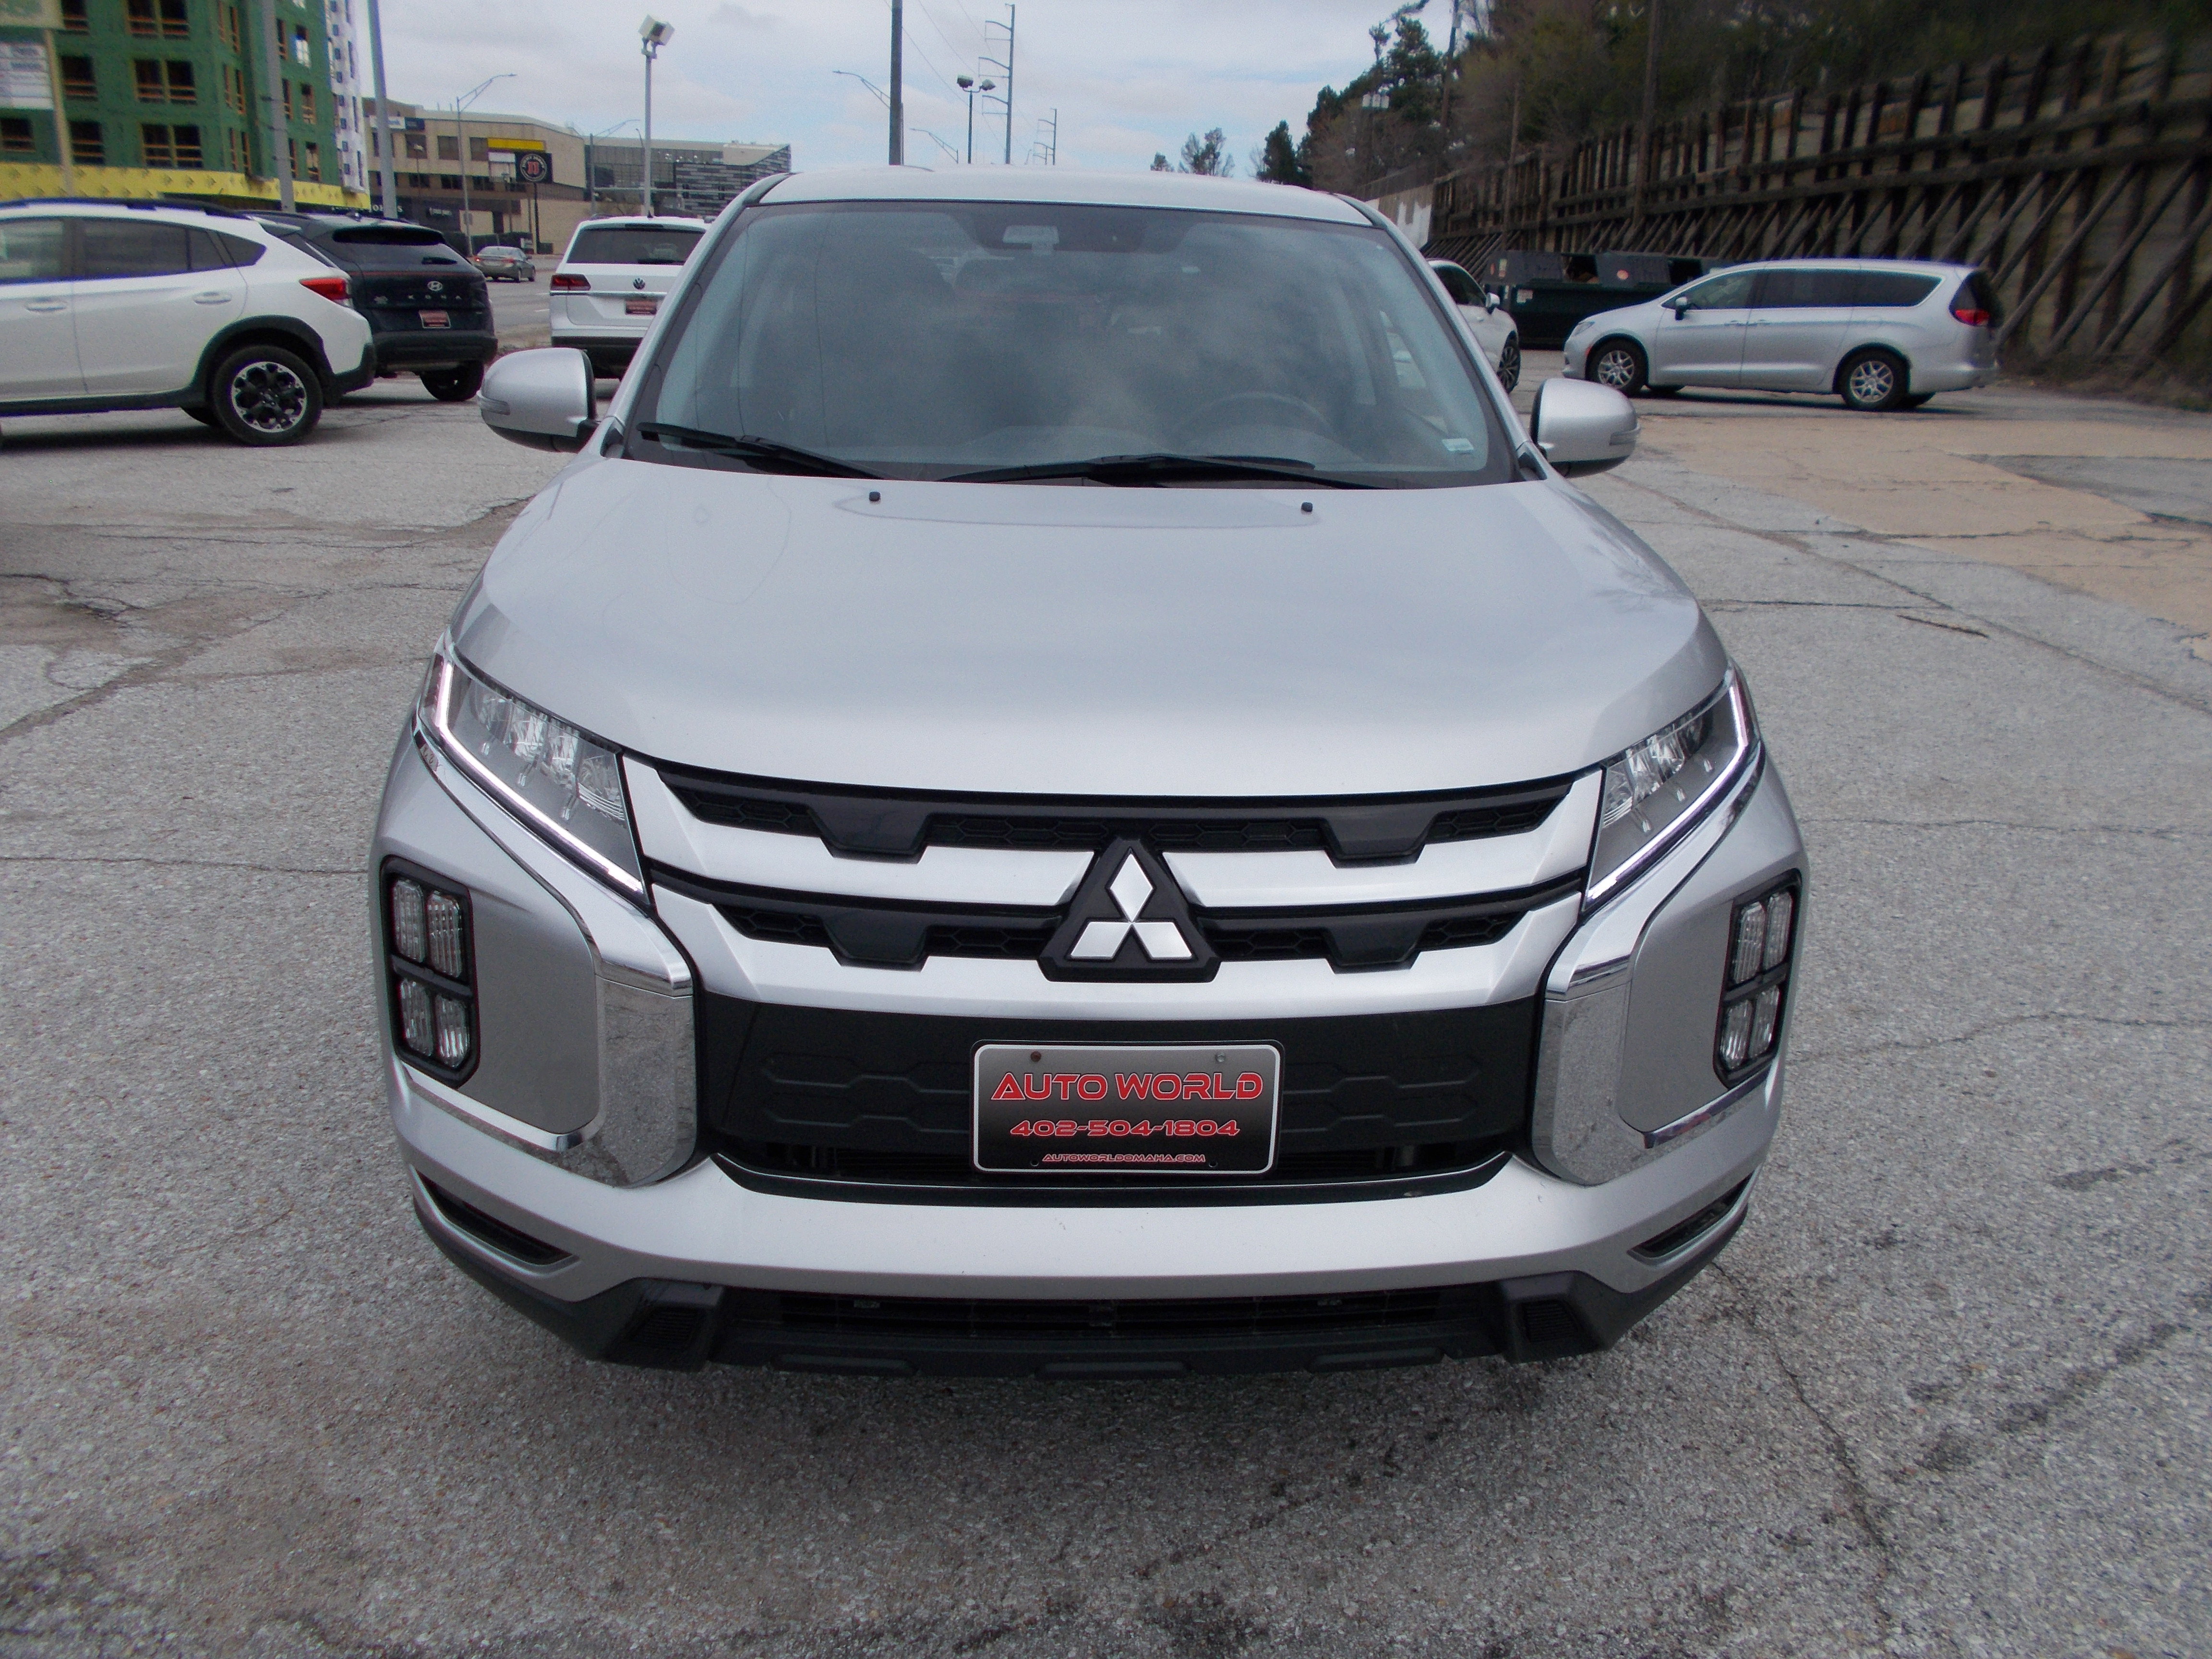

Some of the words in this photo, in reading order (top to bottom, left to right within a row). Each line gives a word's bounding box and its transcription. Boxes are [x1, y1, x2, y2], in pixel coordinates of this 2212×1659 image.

[991, 1072, 1108, 1100] AUTO
[1115, 1072, 1263, 1100] WORLD
[1010, 1119, 1240, 1136] 402-504-1804
[1042, 1154, 1206, 1163] AUTOWORLDOMAHA.COM
